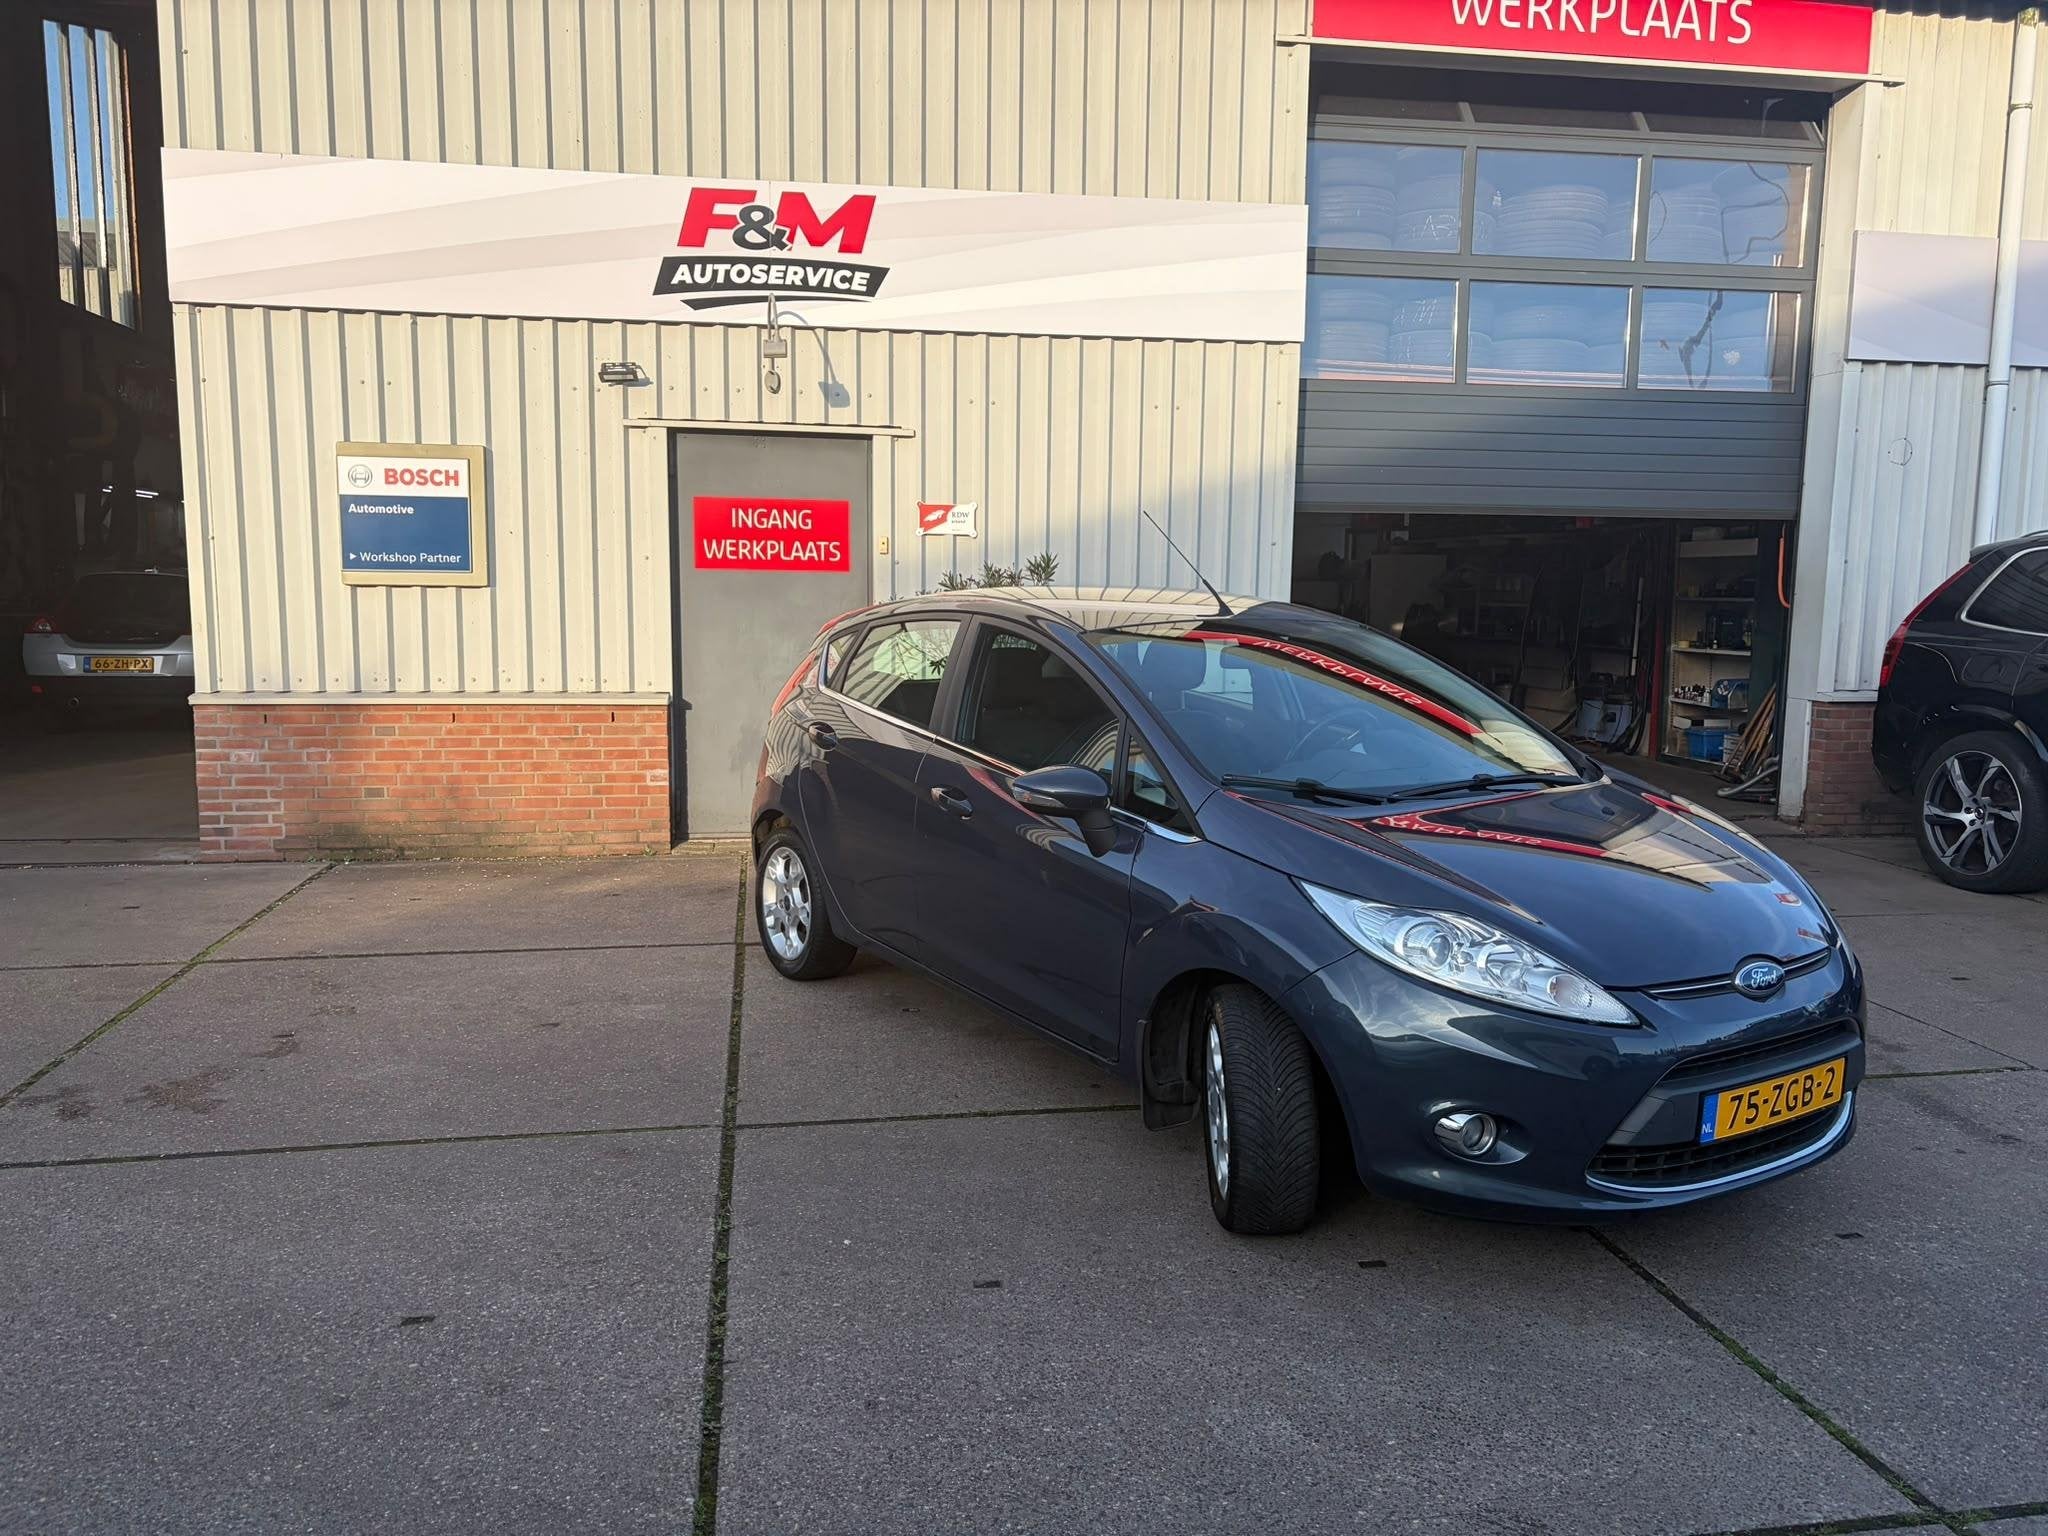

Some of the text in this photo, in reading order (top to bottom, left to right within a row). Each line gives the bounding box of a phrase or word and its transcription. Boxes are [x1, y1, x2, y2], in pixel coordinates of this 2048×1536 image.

[1452, 0, 1752, 44] WERKPLAATS
[677, 187, 877, 254] F&M
[670, 263, 871, 292] AUTOSERVICE
[384, 467, 460, 487] BOSCH
[348, 503, 414, 515] Automotive
[731, 507, 813, 530] INGANG
[360, 551, 462, 564] Workshop Partner
[703, 538, 841, 562] WERKPLAATS
[1751, 967, 1778, 989] Ford
[1727, 1066, 1836, 1130] 75-ZGB-2
[1702, 1123, 1713, 1135] NL
